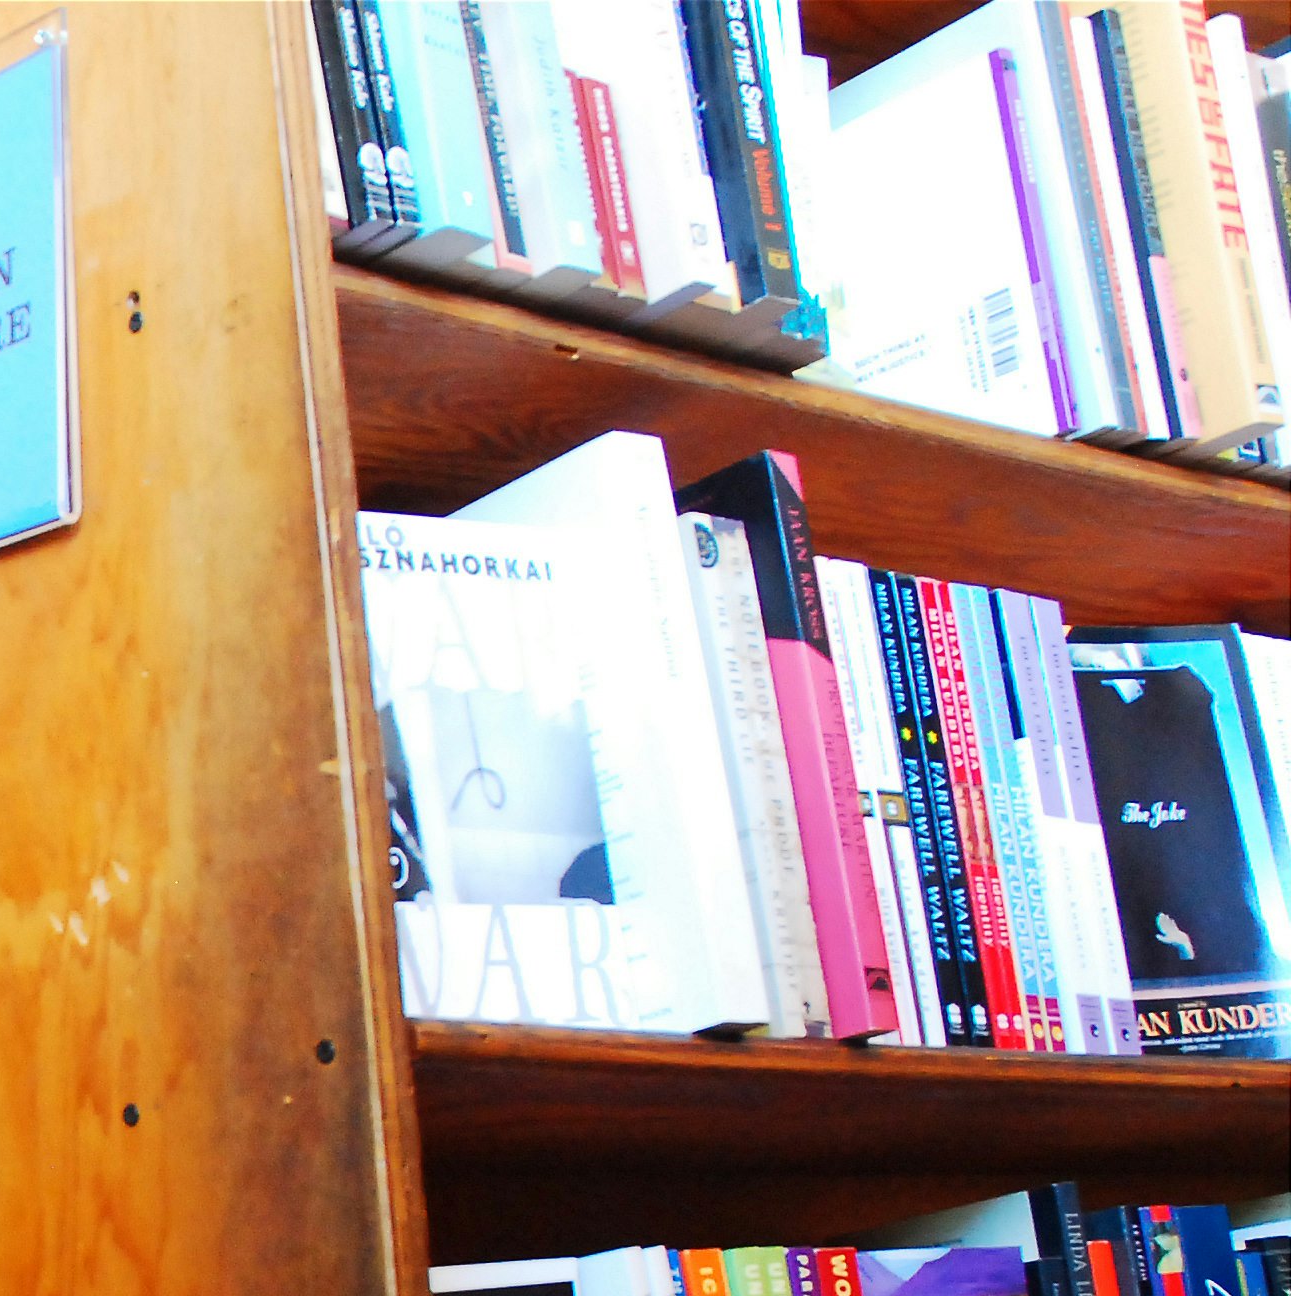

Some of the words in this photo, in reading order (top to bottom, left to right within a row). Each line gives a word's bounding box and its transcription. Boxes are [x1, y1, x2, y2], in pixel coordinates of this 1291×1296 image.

[729, 18, 748, 45] OF
[732, 46, 755, 87] THE
[738, 81, 767, 144] SPIRIT
[751, 147, 777, 218] Volume
[1209, 139, 1249, 253] FATE
[785, 504, 809, 565] JAAN
[875, 581, 894, 635] MILAN
[899, 585, 920, 640] MILAN
[927, 606, 945, 669] MILAN
[882, 638, 908, 715] KUNDERA
[909, 643, 934, 719] KUNDERA
[943, 609, 963, 671] MILAN
[953, 675, 981, 772] KUNDERA
[935, 673, 964, 770] KUNDERA
[902, 758, 936, 875] FAREWELL
[928, 760, 964, 879] FAREWELL
[1120, 801, 1152, 824] The
[1150, 801, 1187, 829] Joke
[990, 781, 1016, 858] MILAN
[1004, 863, 1036, 981] KUNDERA
[1009, 785, 1035, 861] MILAN
[1023, 866, 1056, 985] KUNDERA
[924, 883, 951, 961] WALTZ
[952, 885, 978, 964] WALTZ
[1065, 1212, 1087, 1272] LINDA
